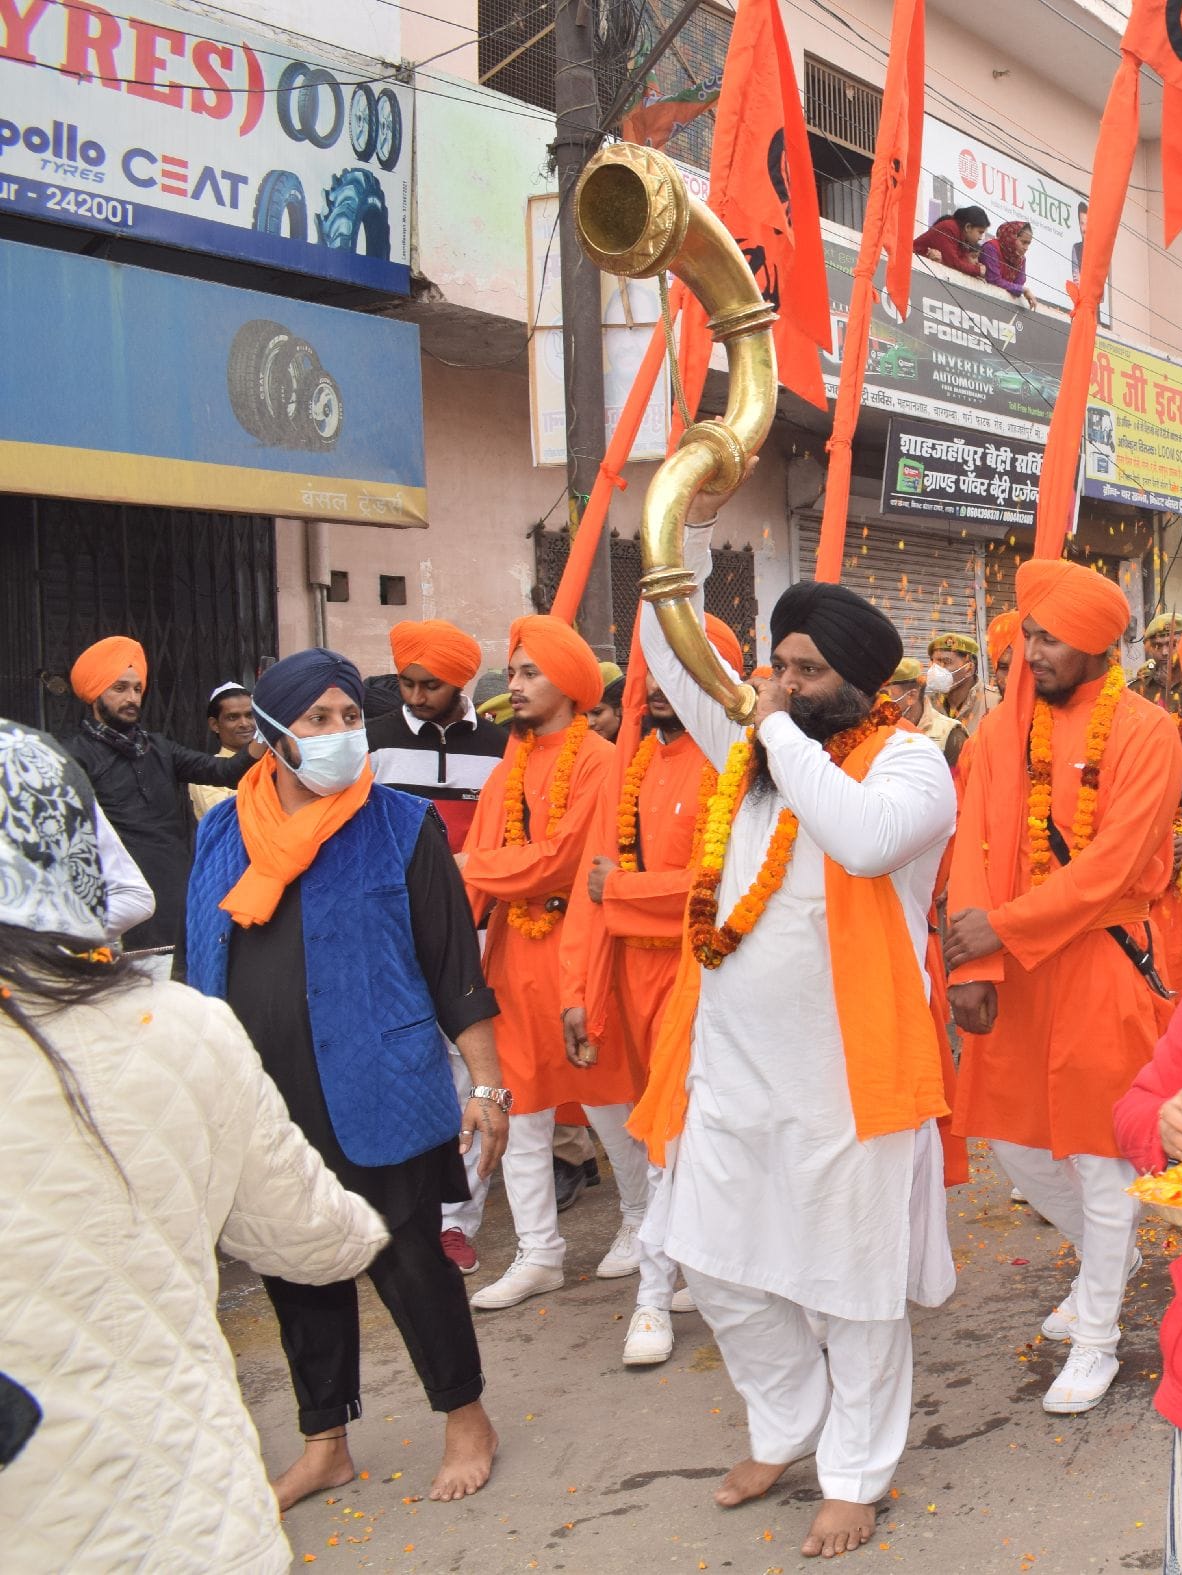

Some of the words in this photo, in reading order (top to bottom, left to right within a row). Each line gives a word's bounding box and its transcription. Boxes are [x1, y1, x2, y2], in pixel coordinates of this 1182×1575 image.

[40, 158, 106, 184] TYRES
[121, 147, 249, 210] CEAT
[46, 187, 134, 226] 242001
[981, 162, 1025, 211] UTL
[1027, 178, 1072, 229] सोलर
[923, 319, 993, 354] POWER
[931, 350, 994, 379] INVERTER
[932, 370, 995, 395] AUTOMOTIVE
[1120, 363, 1148, 414] जी
[300, 482, 348, 512] बंसल
[357, 488, 405, 517] ट्रेडर्स
